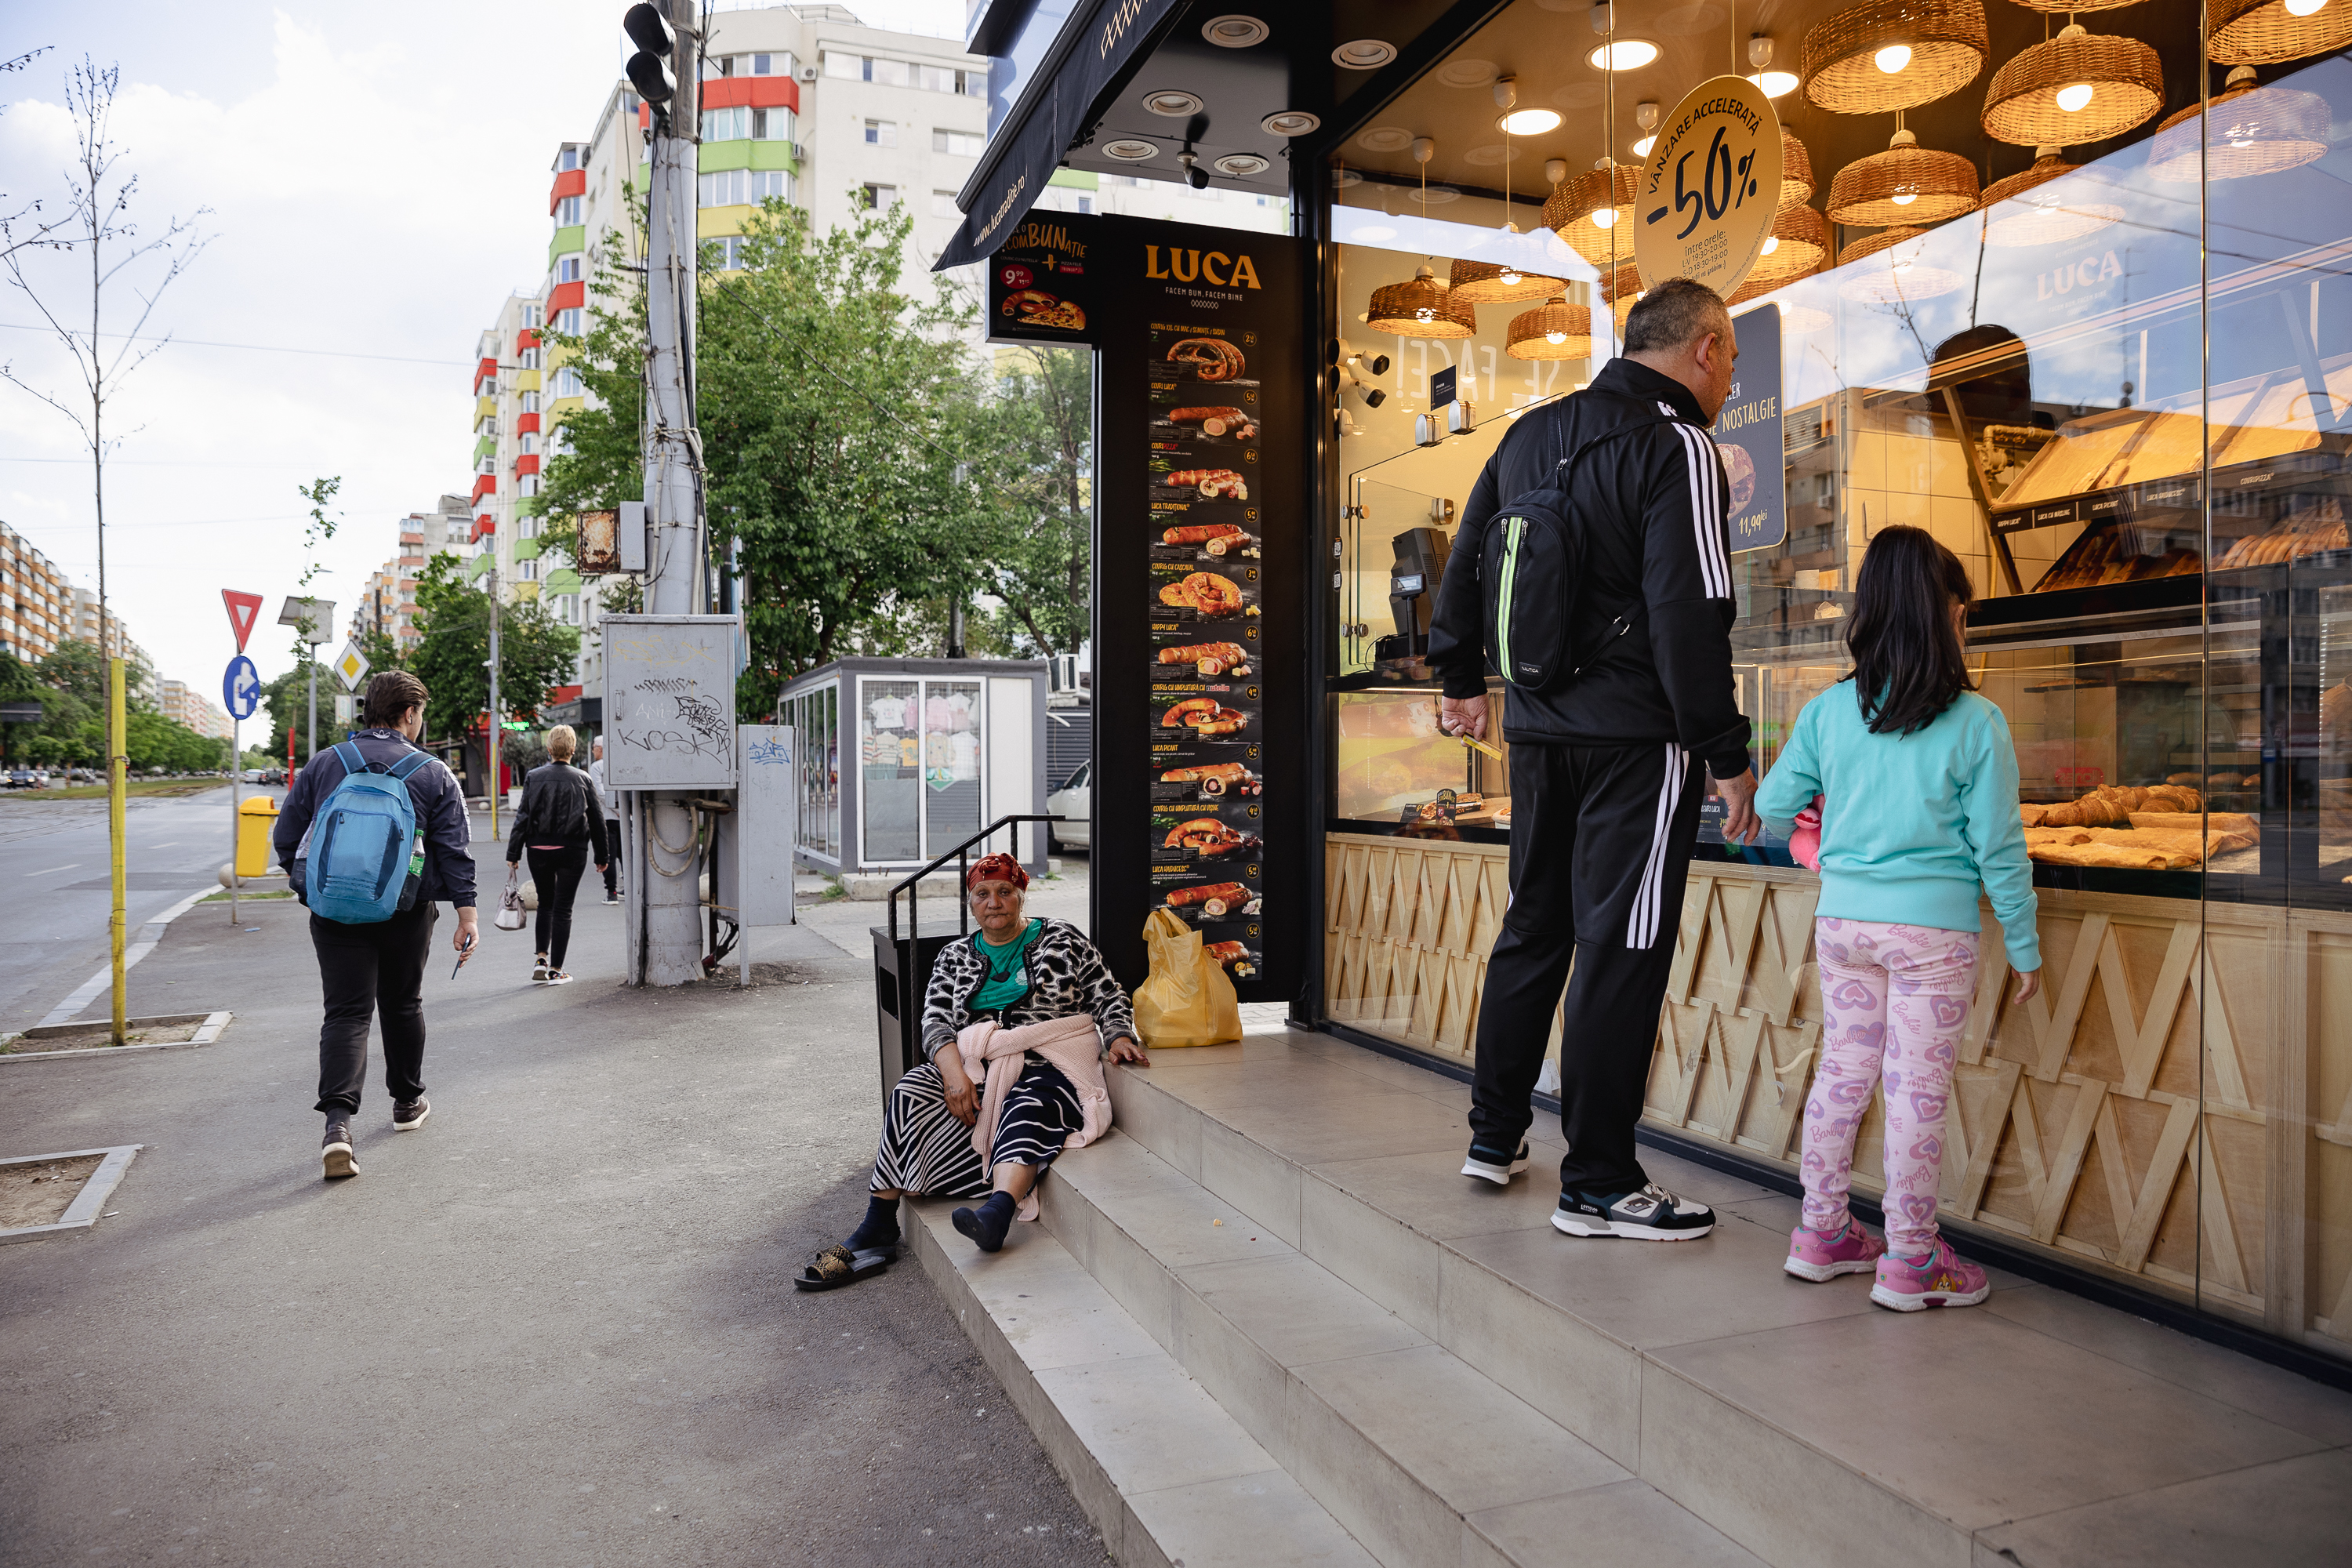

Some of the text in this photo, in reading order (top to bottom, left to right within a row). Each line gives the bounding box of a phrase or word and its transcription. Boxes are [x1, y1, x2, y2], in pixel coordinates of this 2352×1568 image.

[1649, 98, 1762, 194] VÂNZARE ACCELERATĂ
[1647, 126, 1757, 240] -50%
[1684, 230, 1726, 256] între orele:
[1692, 239, 1728, 262] 19:30-20:00
[1145, 245, 1261, 290] LUCA
[1682, 267, 1693, 278] S-D
[1693, 249, 1728, 271] 18:30-19:00
[2036, 250, 2123, 303] LUCA
[1206, 291, 1226, 299] FACEM
[1722, 397, 1777, 433] NOSTALGIE
[1887, 924, 1932, 949] Barbie
[1929, 968, 1965, 993] Barbie
[1892, 1000, 1920, 1035] Barbie
[1829, 1029, 1866, 1051] Barbie
[1908, 1068, 1946, 1090] Barbie
[1810, 1122, 1849, 1143] Barbie
[1896, 1165, 1932, 1190] Barbie
